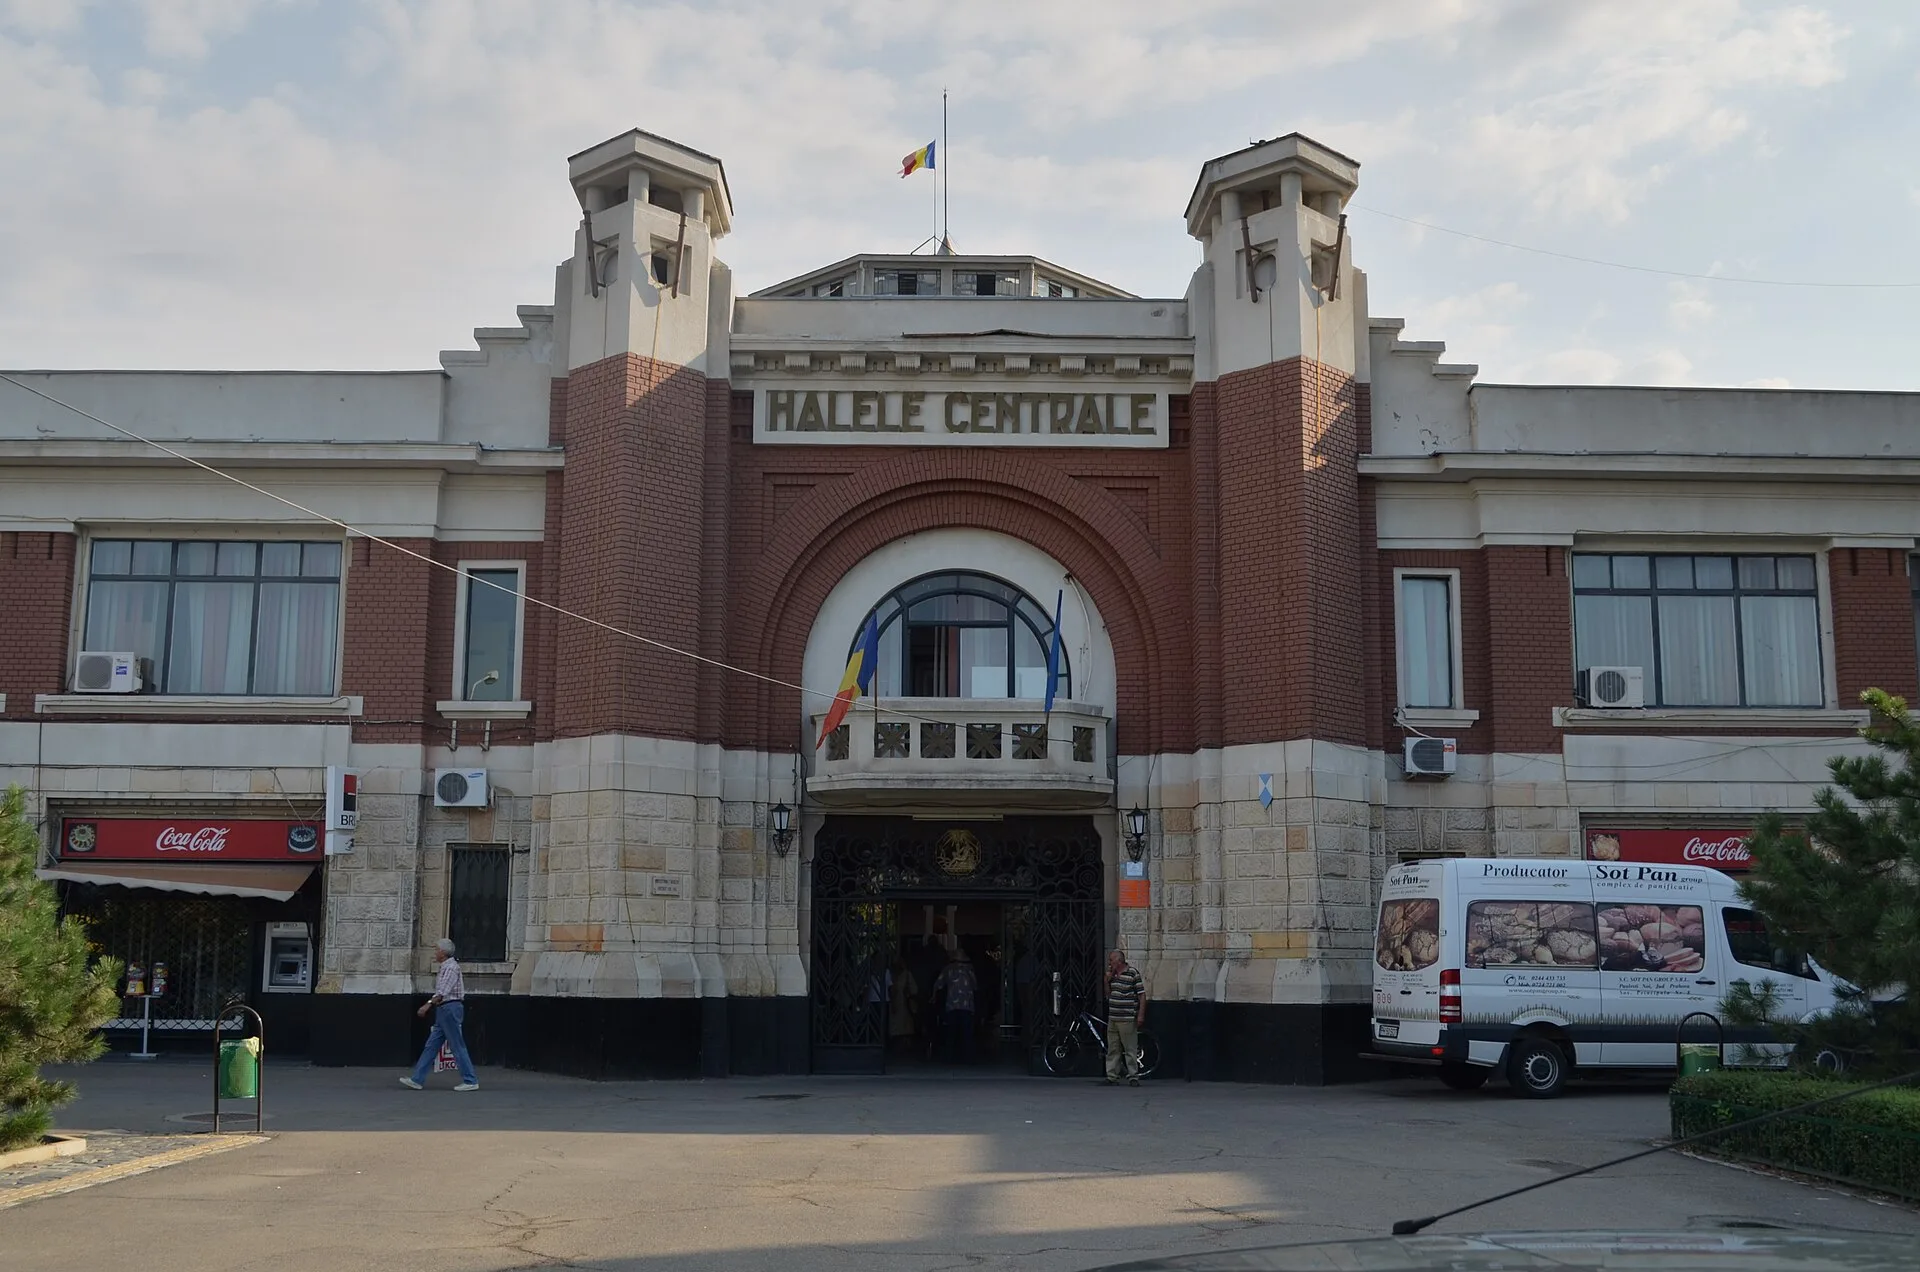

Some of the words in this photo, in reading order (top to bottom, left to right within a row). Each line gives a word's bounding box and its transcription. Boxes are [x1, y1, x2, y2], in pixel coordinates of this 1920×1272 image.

[768, 390, 926, 432] HALELE
[943, 391, 1158, 435] CENTRALE
[1482, 864, 1569, 878] Producator
[1595, 864, 1630, 881] Sot
[1637, 866, 1678, 882] Pan
[1389, 875, 1401, 887] Sot
[1402, 874, 1418, 885] Pan
[1596, 881, 1632, 889] complex
[1647, 882, 1694, 891] panificatie
